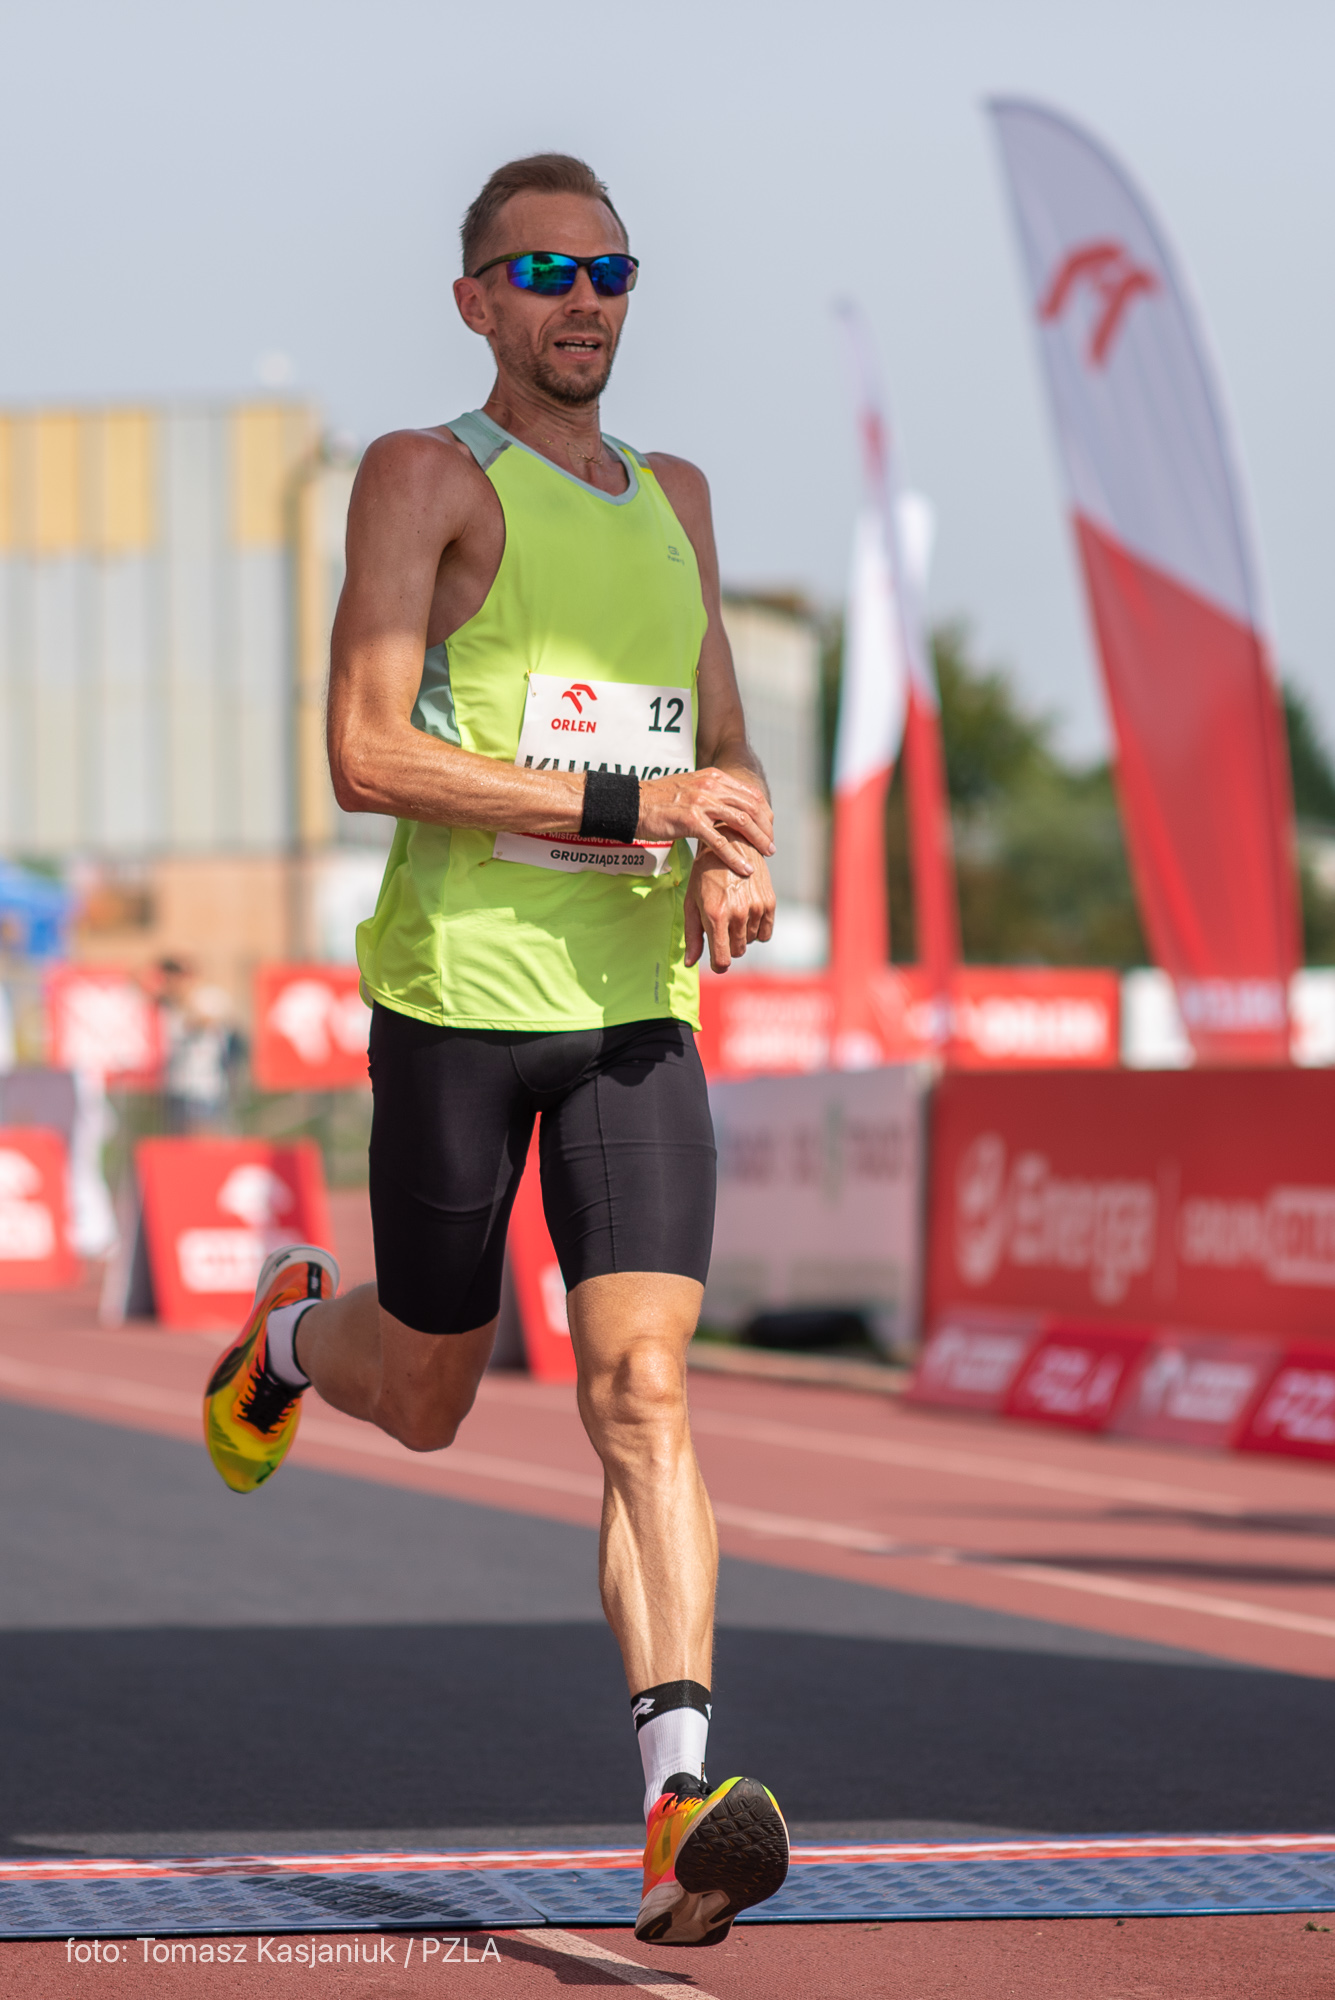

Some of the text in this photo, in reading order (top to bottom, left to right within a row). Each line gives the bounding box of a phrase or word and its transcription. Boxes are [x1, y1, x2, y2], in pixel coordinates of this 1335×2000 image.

[648, 697, 684, 733] 12
[551, 718, 597, 734] ORLEN
[550, 849, 645, 867] GRUDZIĄDZ 2023
